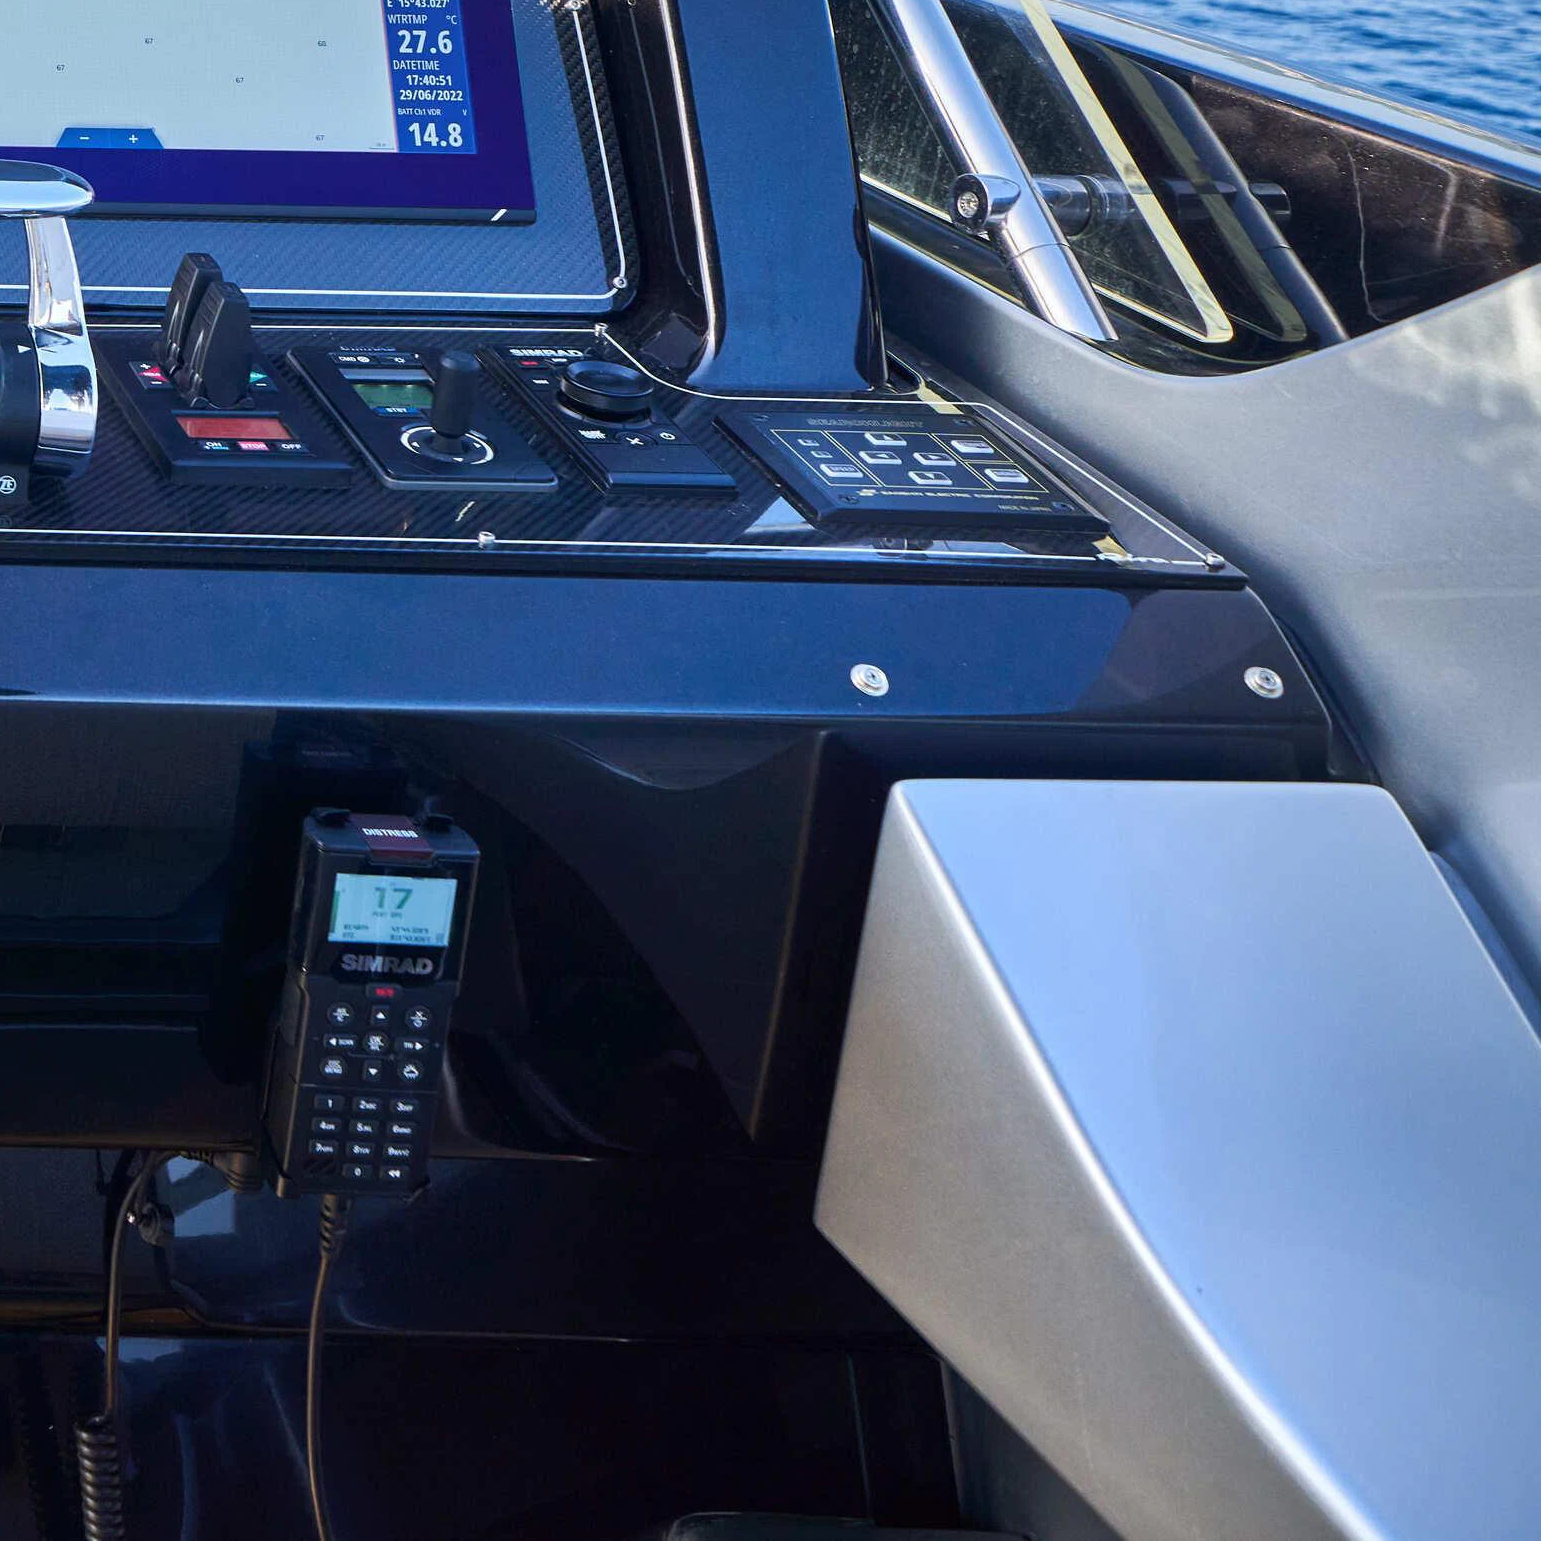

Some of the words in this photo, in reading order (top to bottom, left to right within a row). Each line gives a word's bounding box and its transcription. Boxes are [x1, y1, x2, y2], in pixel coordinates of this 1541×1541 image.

[387, 14, 428, 25] WTRTMP
[397, 29, 453, 54] 27.6
[56, 64, 65, 72] 67
[393, 59, 440, 70] DATETIME
[406, 74, 453, 86] 17:40:51
[399, 89, 464, 101] 29/06/2022
[427, 108, 441, 116] VDR
[408, 122, 463, 147] 14.8
[509, 348, 583, 357] SIMRAD
[361, 827, 419, 838] DISTRESS
[374, 886, 414, 910] 17
[341, 953, 433, 975] SIMRAD
